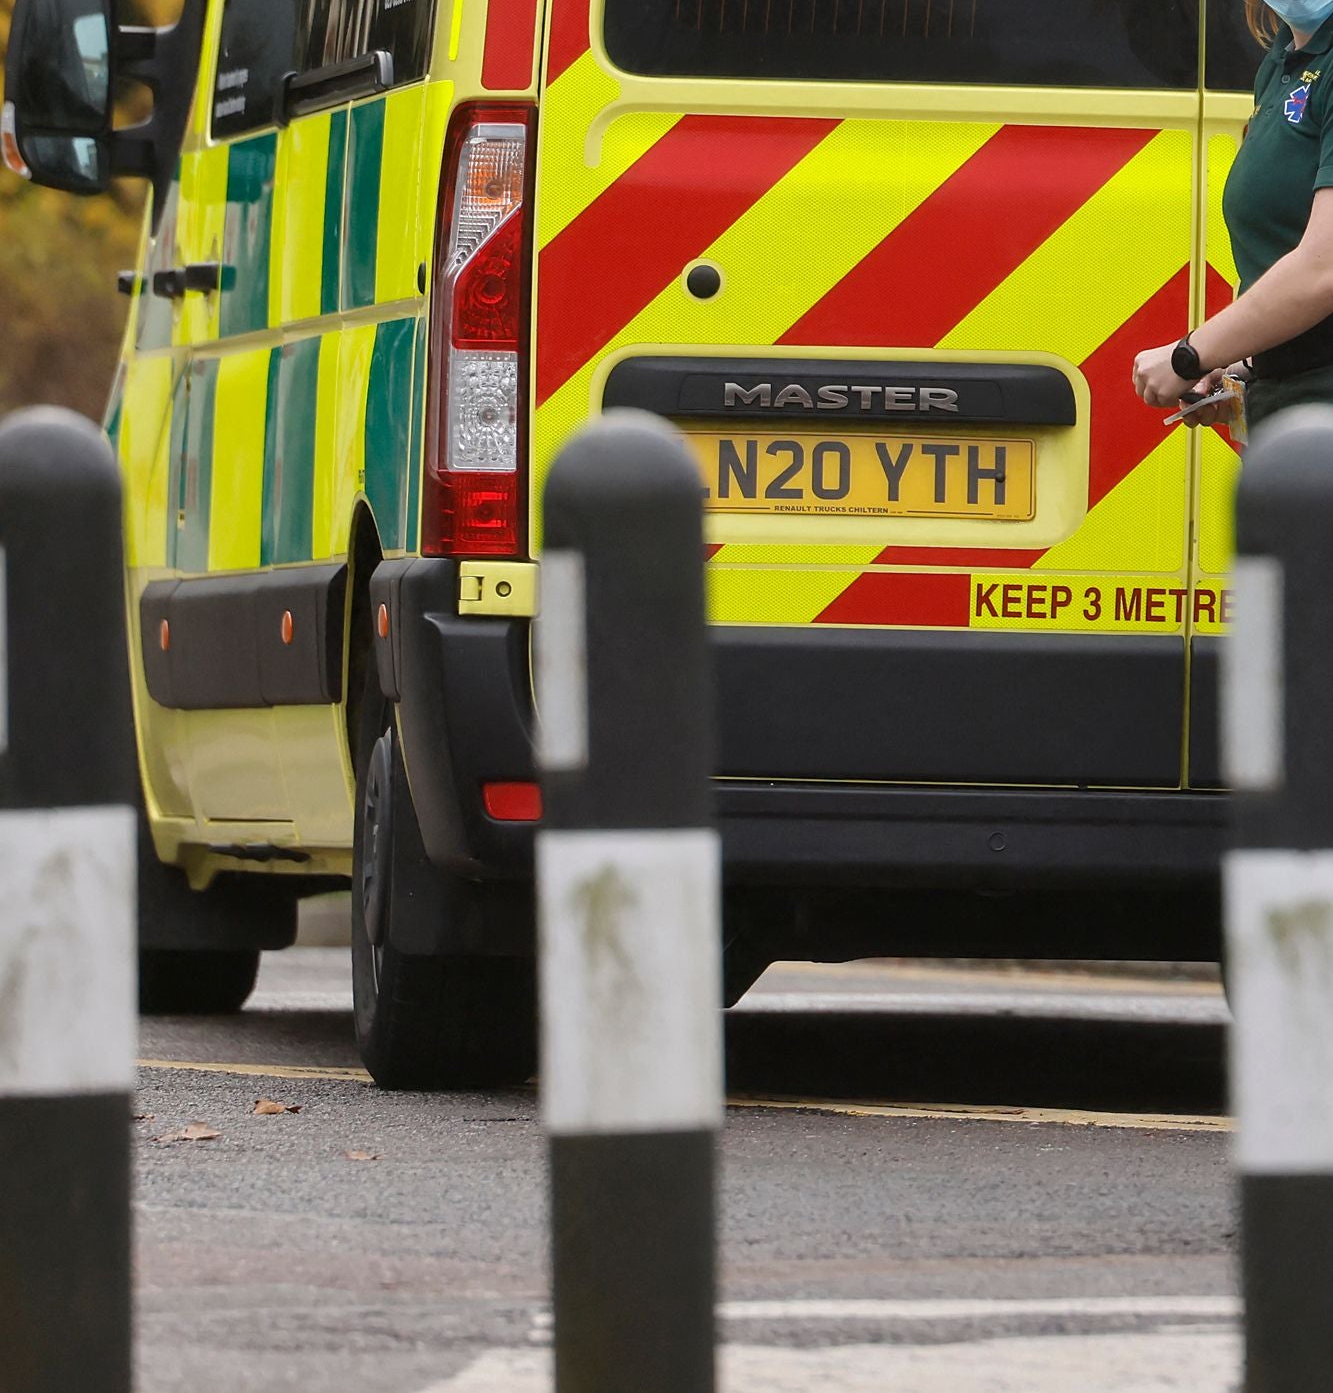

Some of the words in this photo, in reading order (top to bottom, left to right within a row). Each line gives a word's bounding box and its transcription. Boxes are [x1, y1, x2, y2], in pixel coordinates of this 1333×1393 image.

[724, 381, 960, 413] MASTER
[700, 439, 851, 501] N20
[875, 442, 1007, 506] YTH
[774, 505, 812, 513] RENAULT
[814, 506, 847, 514] TRUCKS
[848, 506, 889, 514] CHILTERN
[976, 583, 1073, 619] KEEP
[1083, 585, 1102, 621] 3
